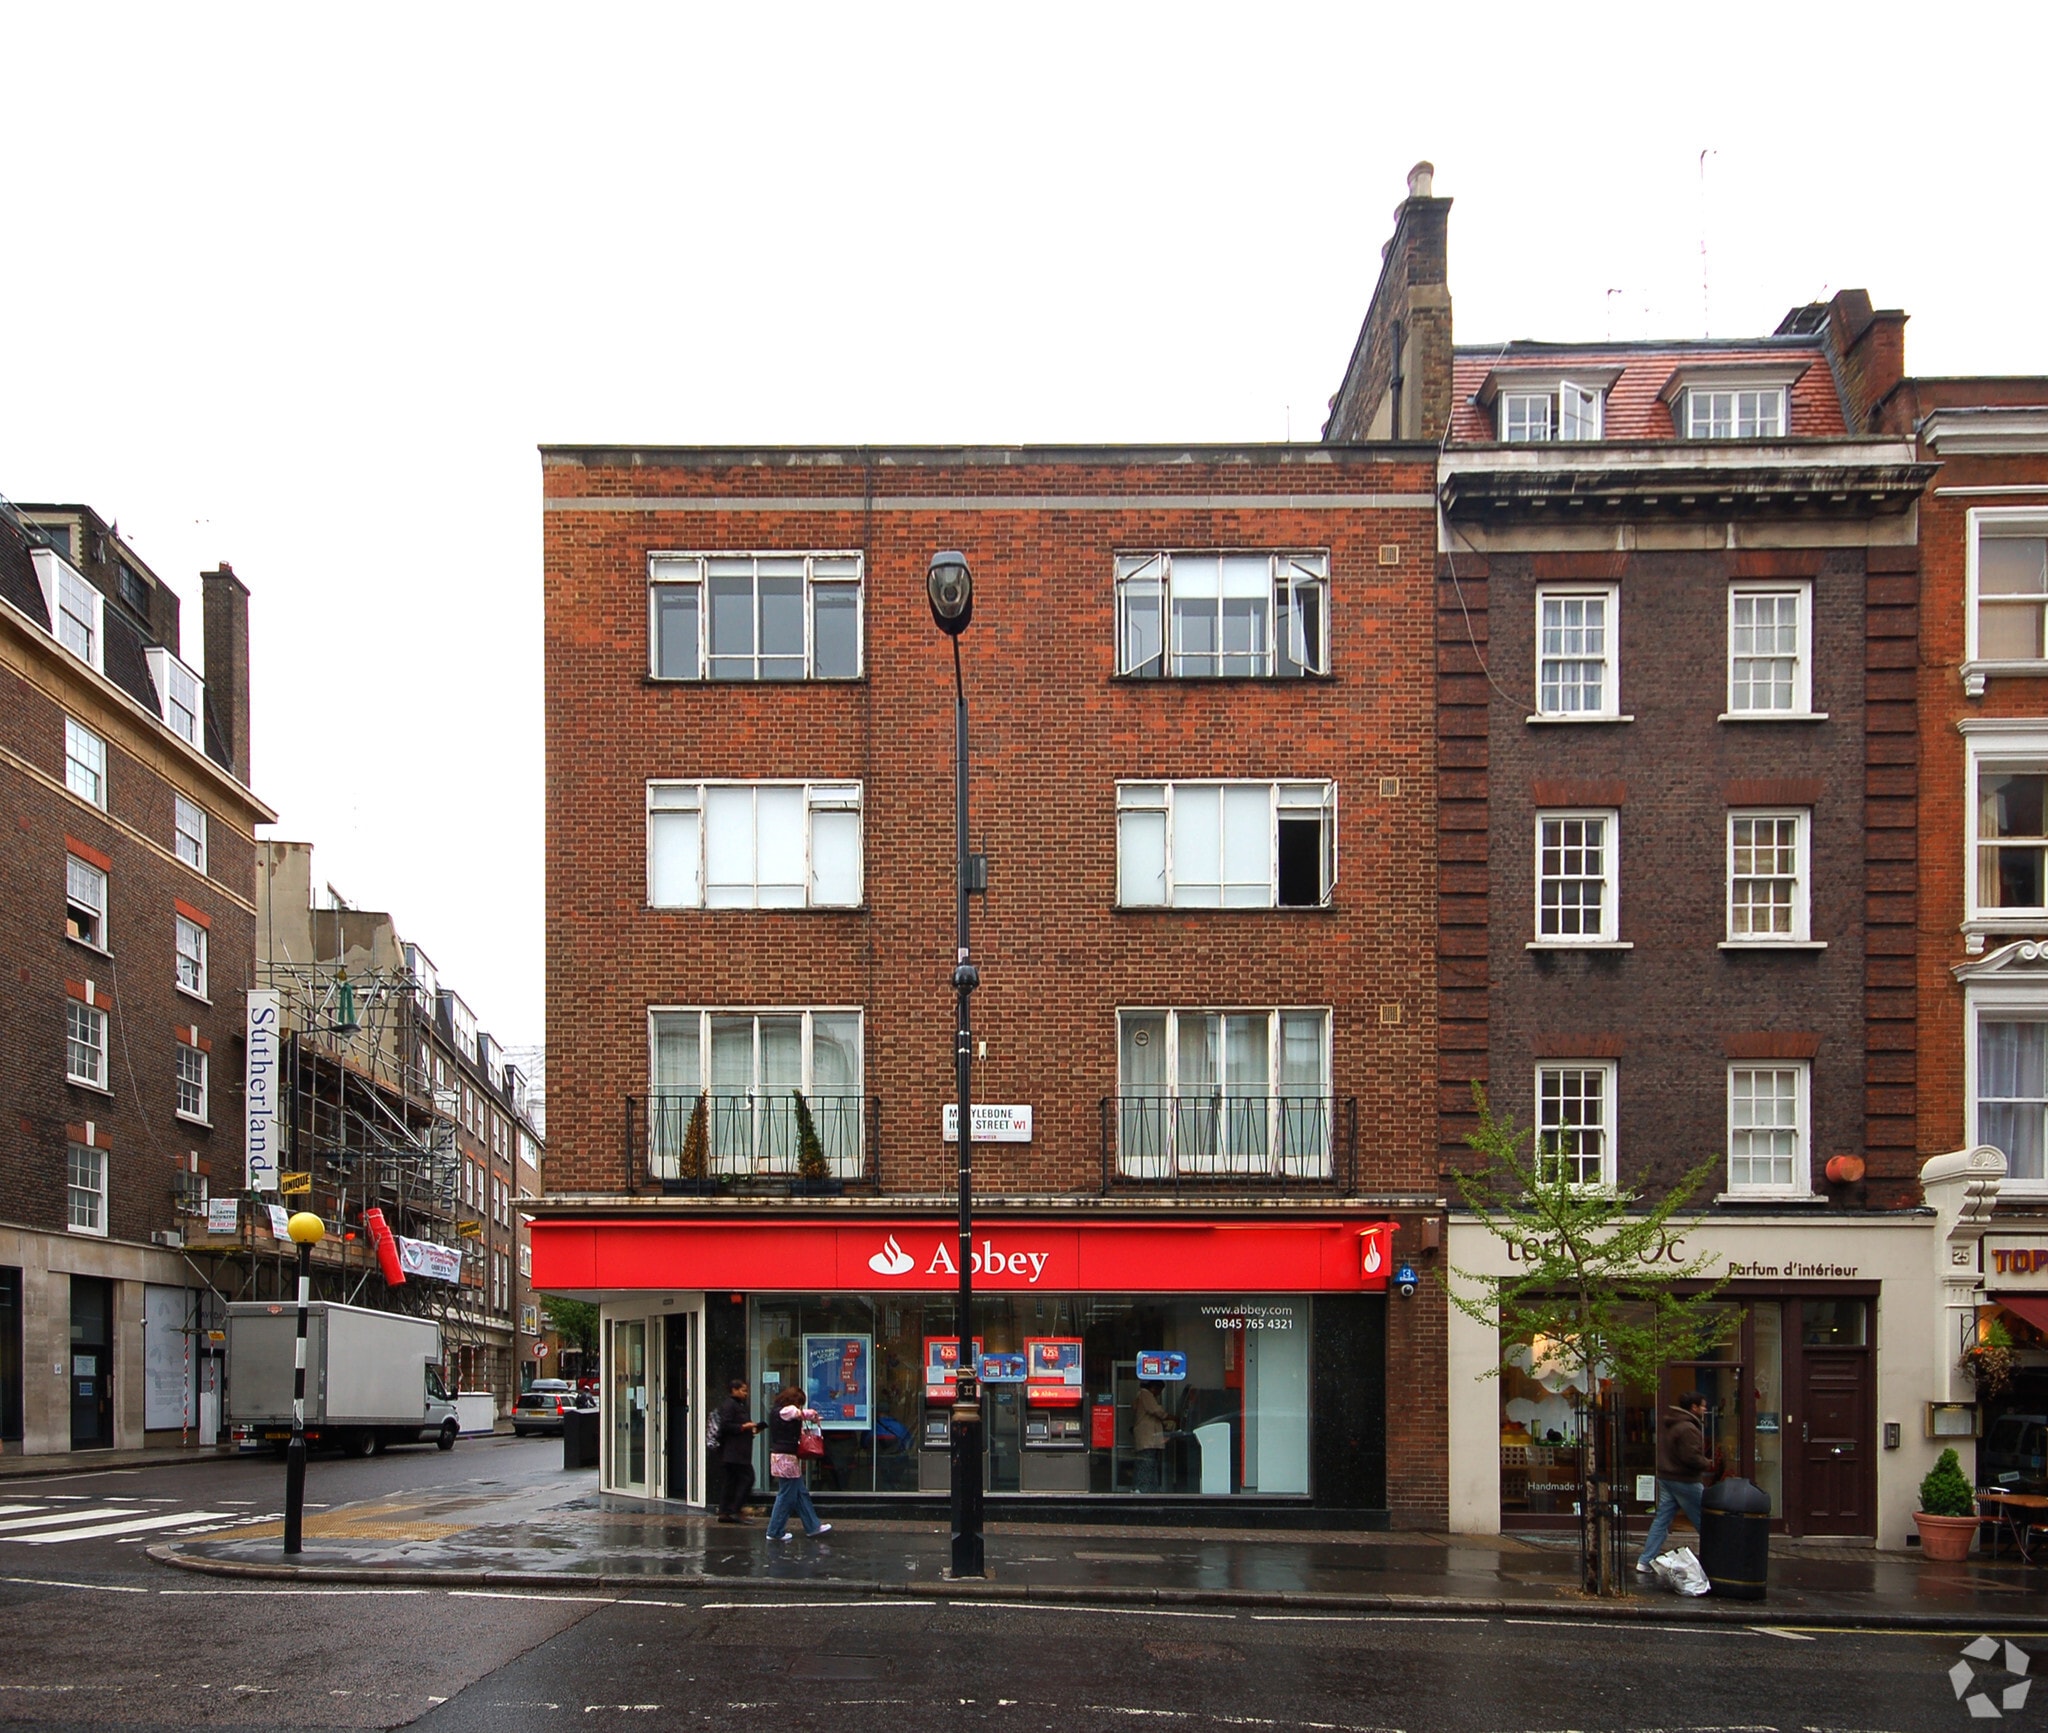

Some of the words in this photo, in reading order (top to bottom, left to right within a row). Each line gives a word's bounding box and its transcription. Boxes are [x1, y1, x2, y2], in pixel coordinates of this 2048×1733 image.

[250, 1008, 275, 1169] Sutherland
[949, 1109, 1013, 1118] MYLEBONE
[976, 1120, 1009, 1130] STREET
[1013, 1121, 1026, 1130] W1
[283, 1174, 310, 1192] UNIQUE
[1953, 1250, 1970, 1264] 25
[1729, 1261, 1778, 1276] Parfum
[1784, 1261, 1858, 1276] d'intérieur
[1201, 1304, 1292, 1317] www.abbey.com
[1215, 1319, 1242, 1329] 0845
[1246, 1319, 1264, 1329] 765
[1267, 1319, 1292, 1329] 4321
[1527, 1482, 1575, 1491] Handmade
